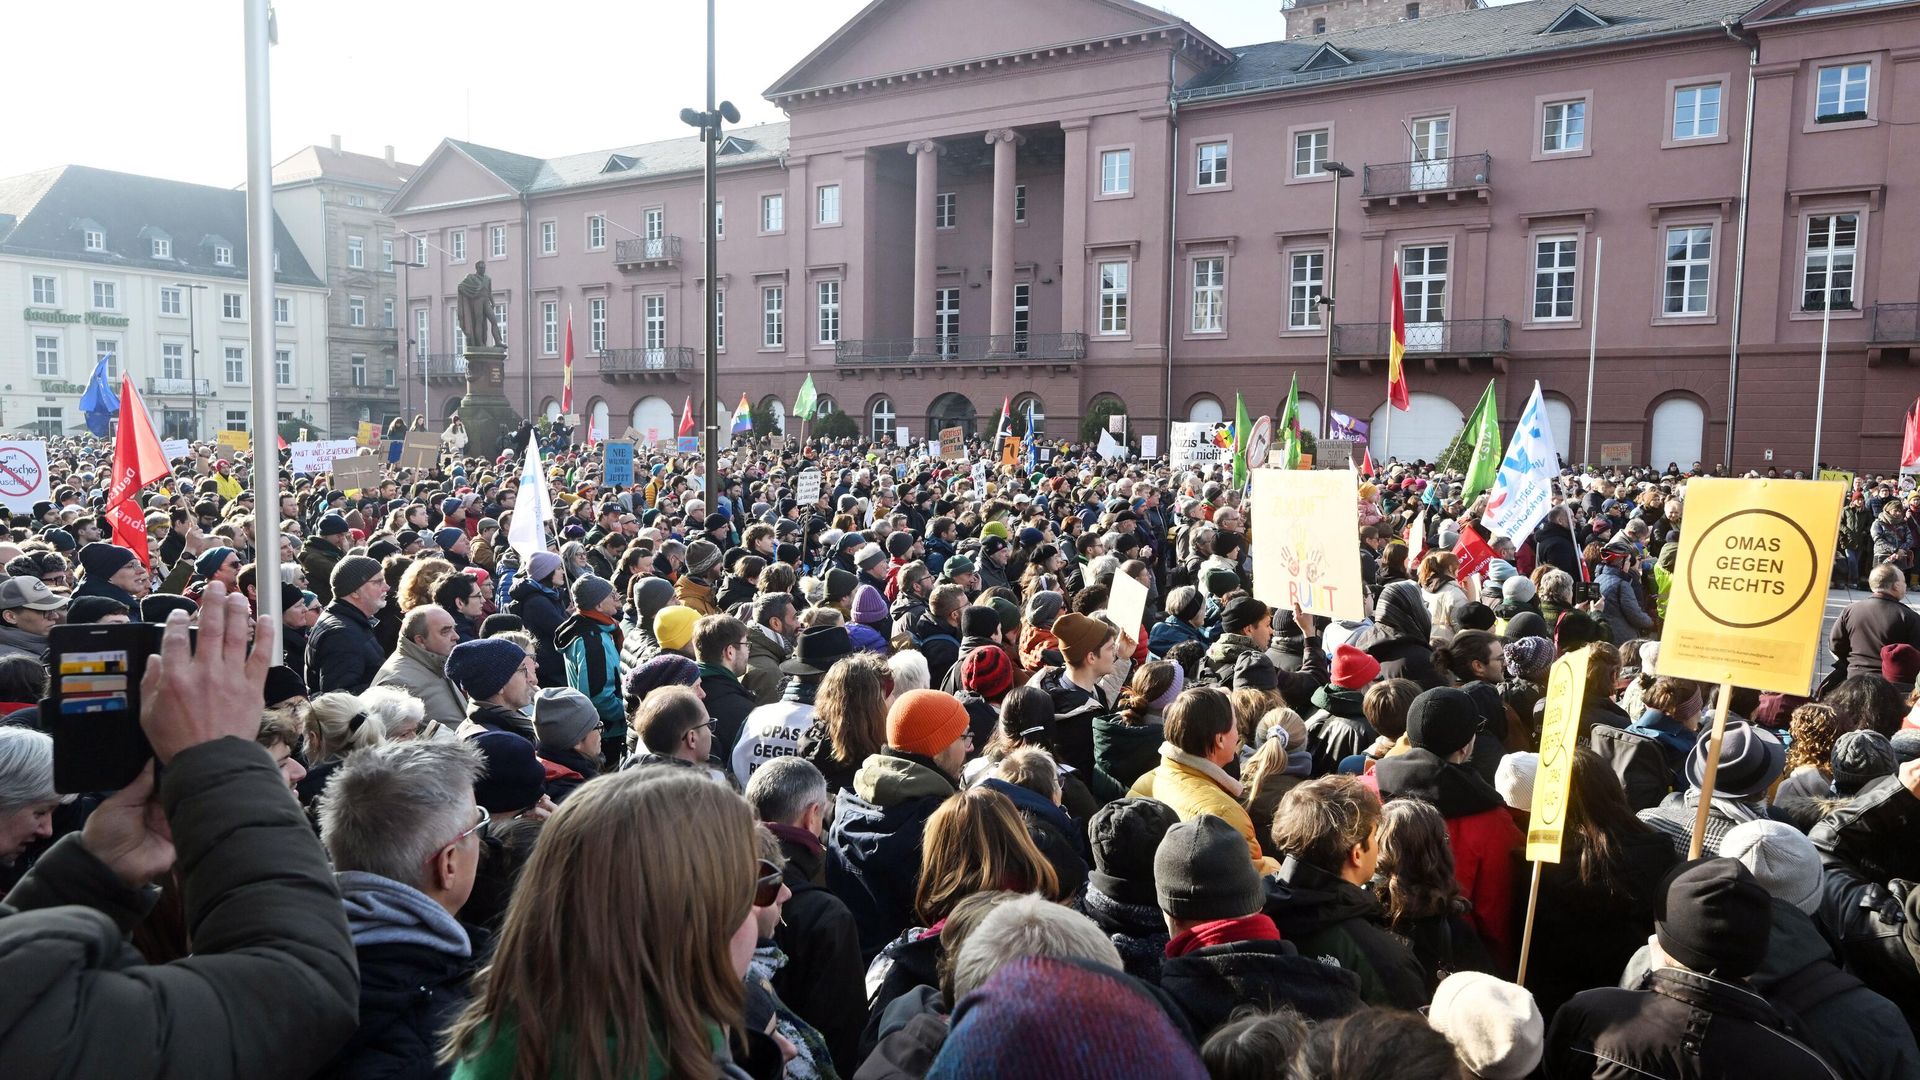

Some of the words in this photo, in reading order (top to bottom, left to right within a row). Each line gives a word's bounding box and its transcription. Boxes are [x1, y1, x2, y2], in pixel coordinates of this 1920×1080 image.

[612, 448, 626, 457] NIE
[1196, 449, 1222, 460] nicht
[1724, 535, 1782, 552] OMAS
[1716, 556, 1784, 574] GEGEN
[1707, 576, 1785, 595] RECHTS
[1288, 580, 1339, 613] BUNT
[762, 725, 801, 742] OPAS
